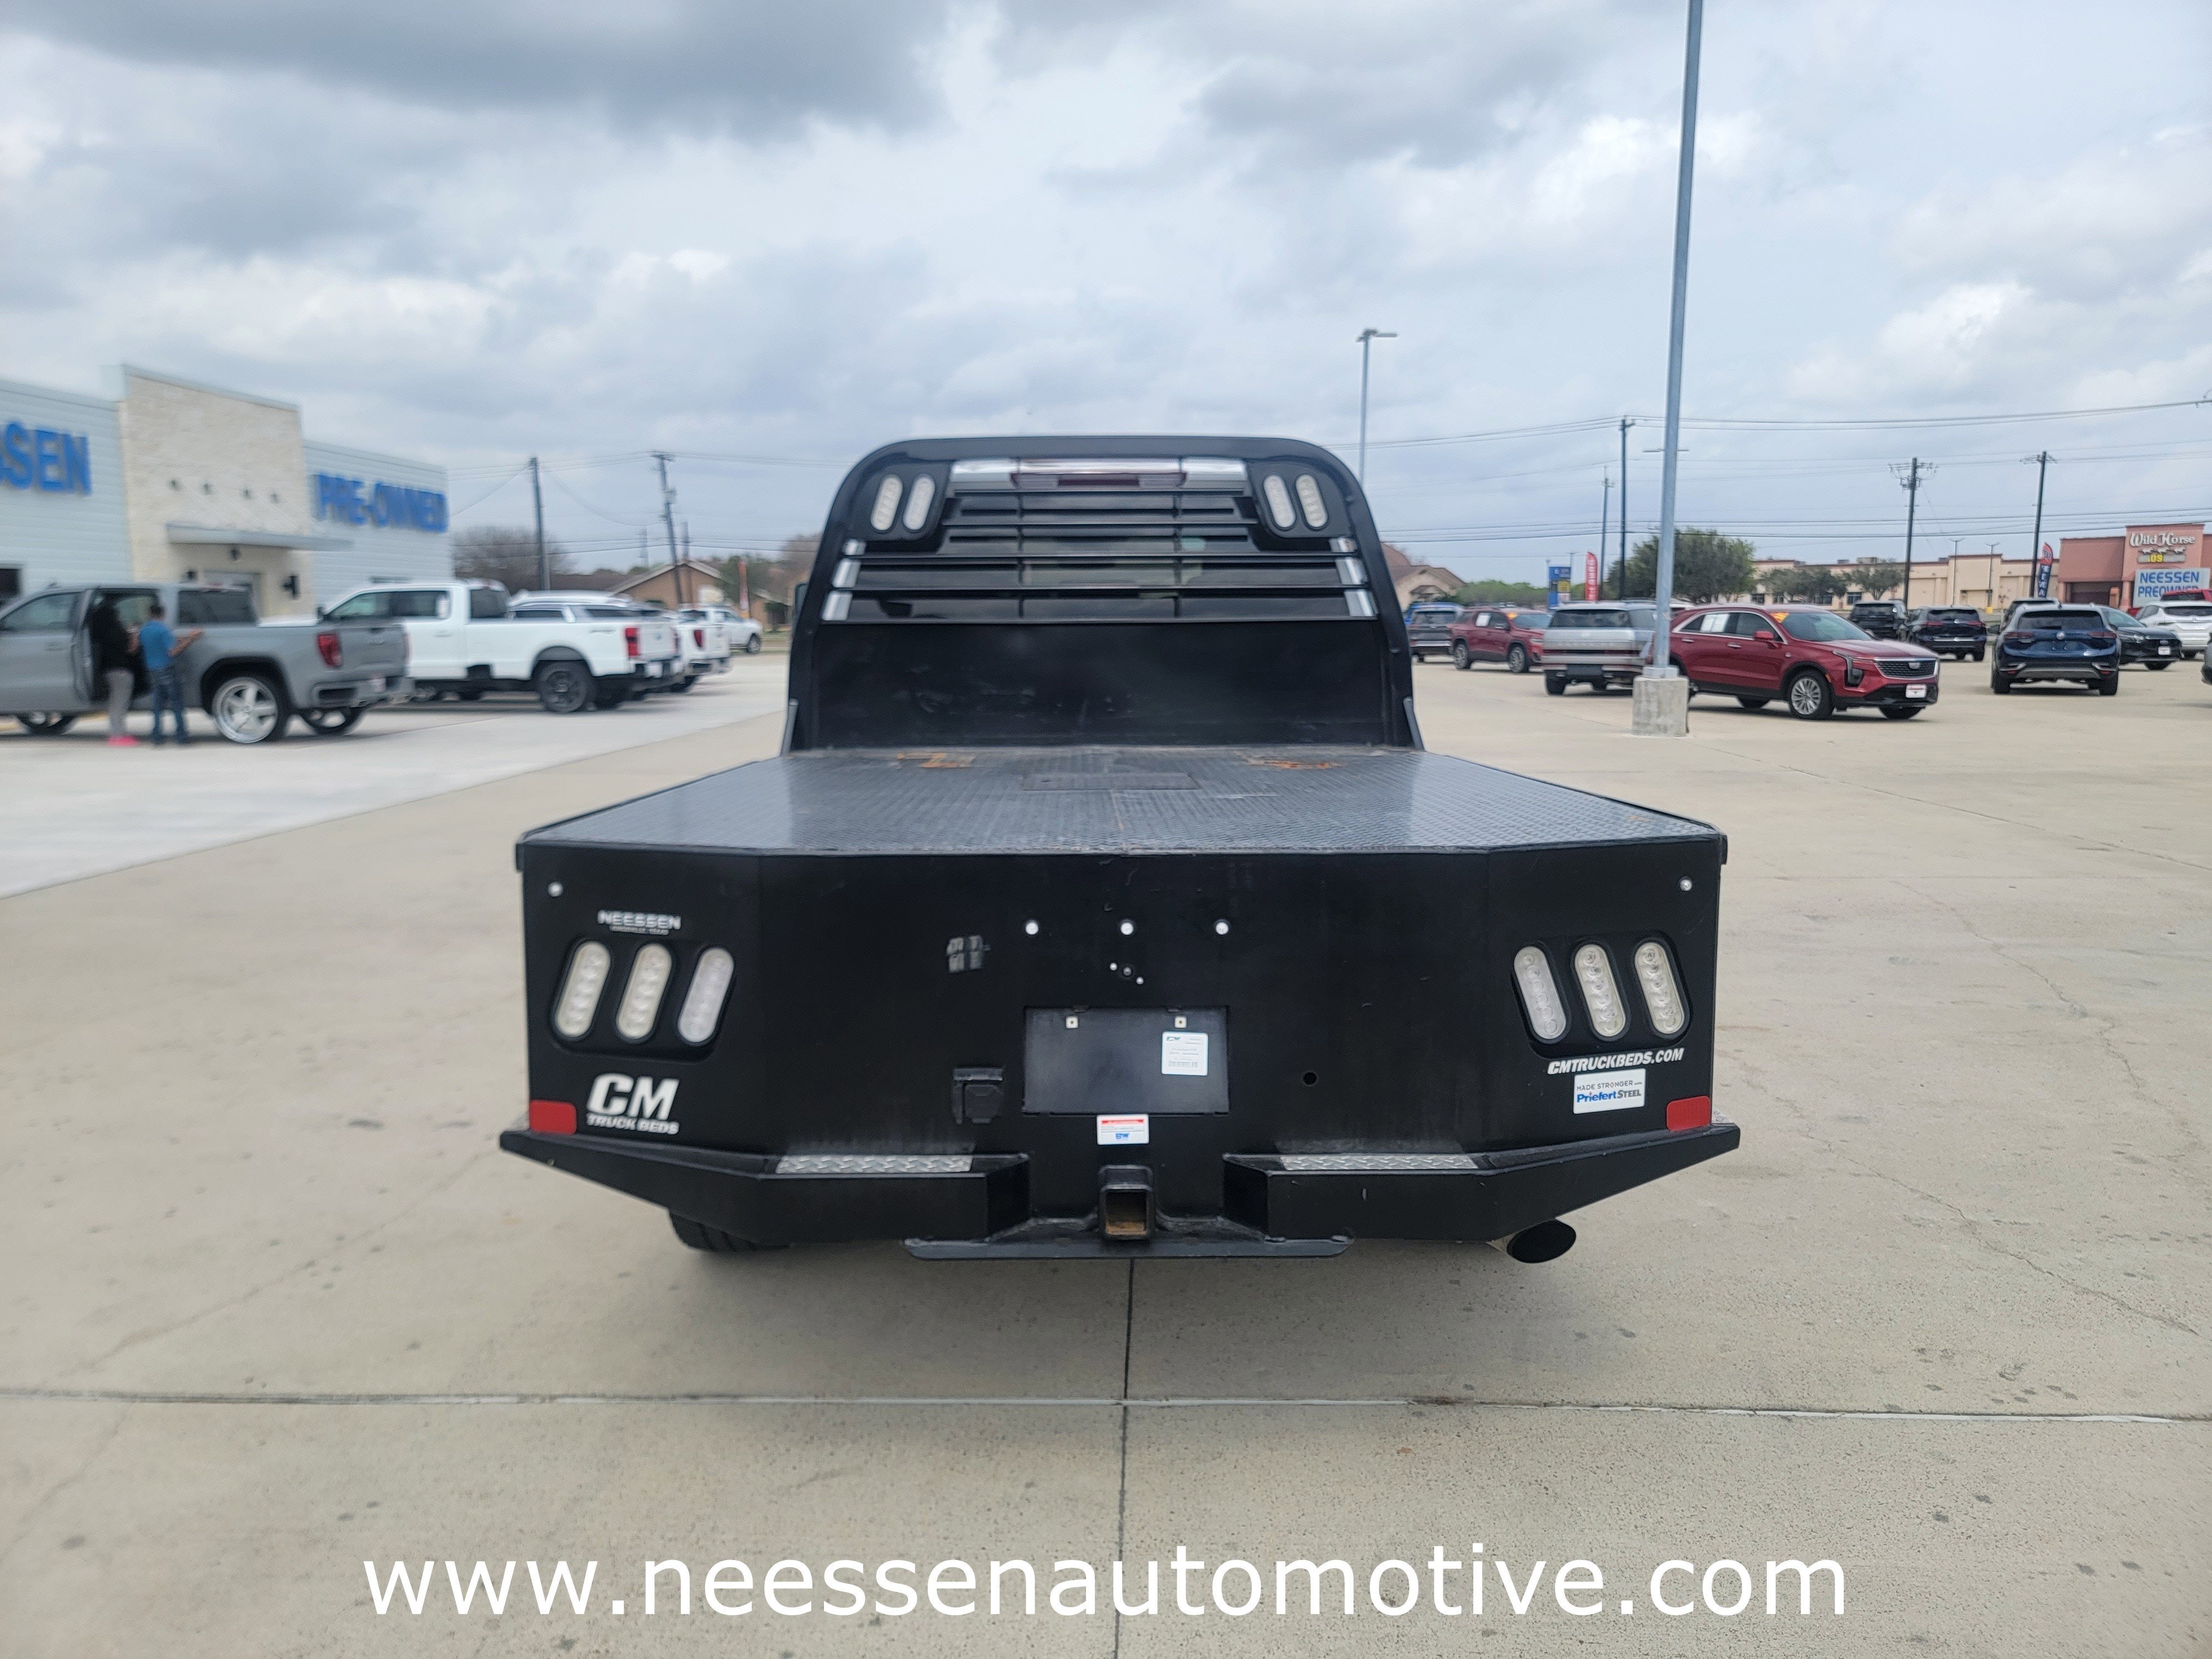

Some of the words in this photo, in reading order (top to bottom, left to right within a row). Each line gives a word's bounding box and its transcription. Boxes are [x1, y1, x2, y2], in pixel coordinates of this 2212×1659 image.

[0, 422, 91, 495] SEN
[2130, 533, 2157, 547] Wild
[2158, 532, 2195, 546] Horse
[2140, 571, 2200, 583] NEESSEN
[597, 910, 681, 930] NEESSEN
[1547, 1047, 1684, 1074] CMTRUCKBEDS.COM
[1597, 1080, 1633, 1090] STRONGER
[586, 1073, 680, 1120] CM
[586, 1112, 637, 1130] TRUCK
[637, 1118, 680, 1135] BEDS
